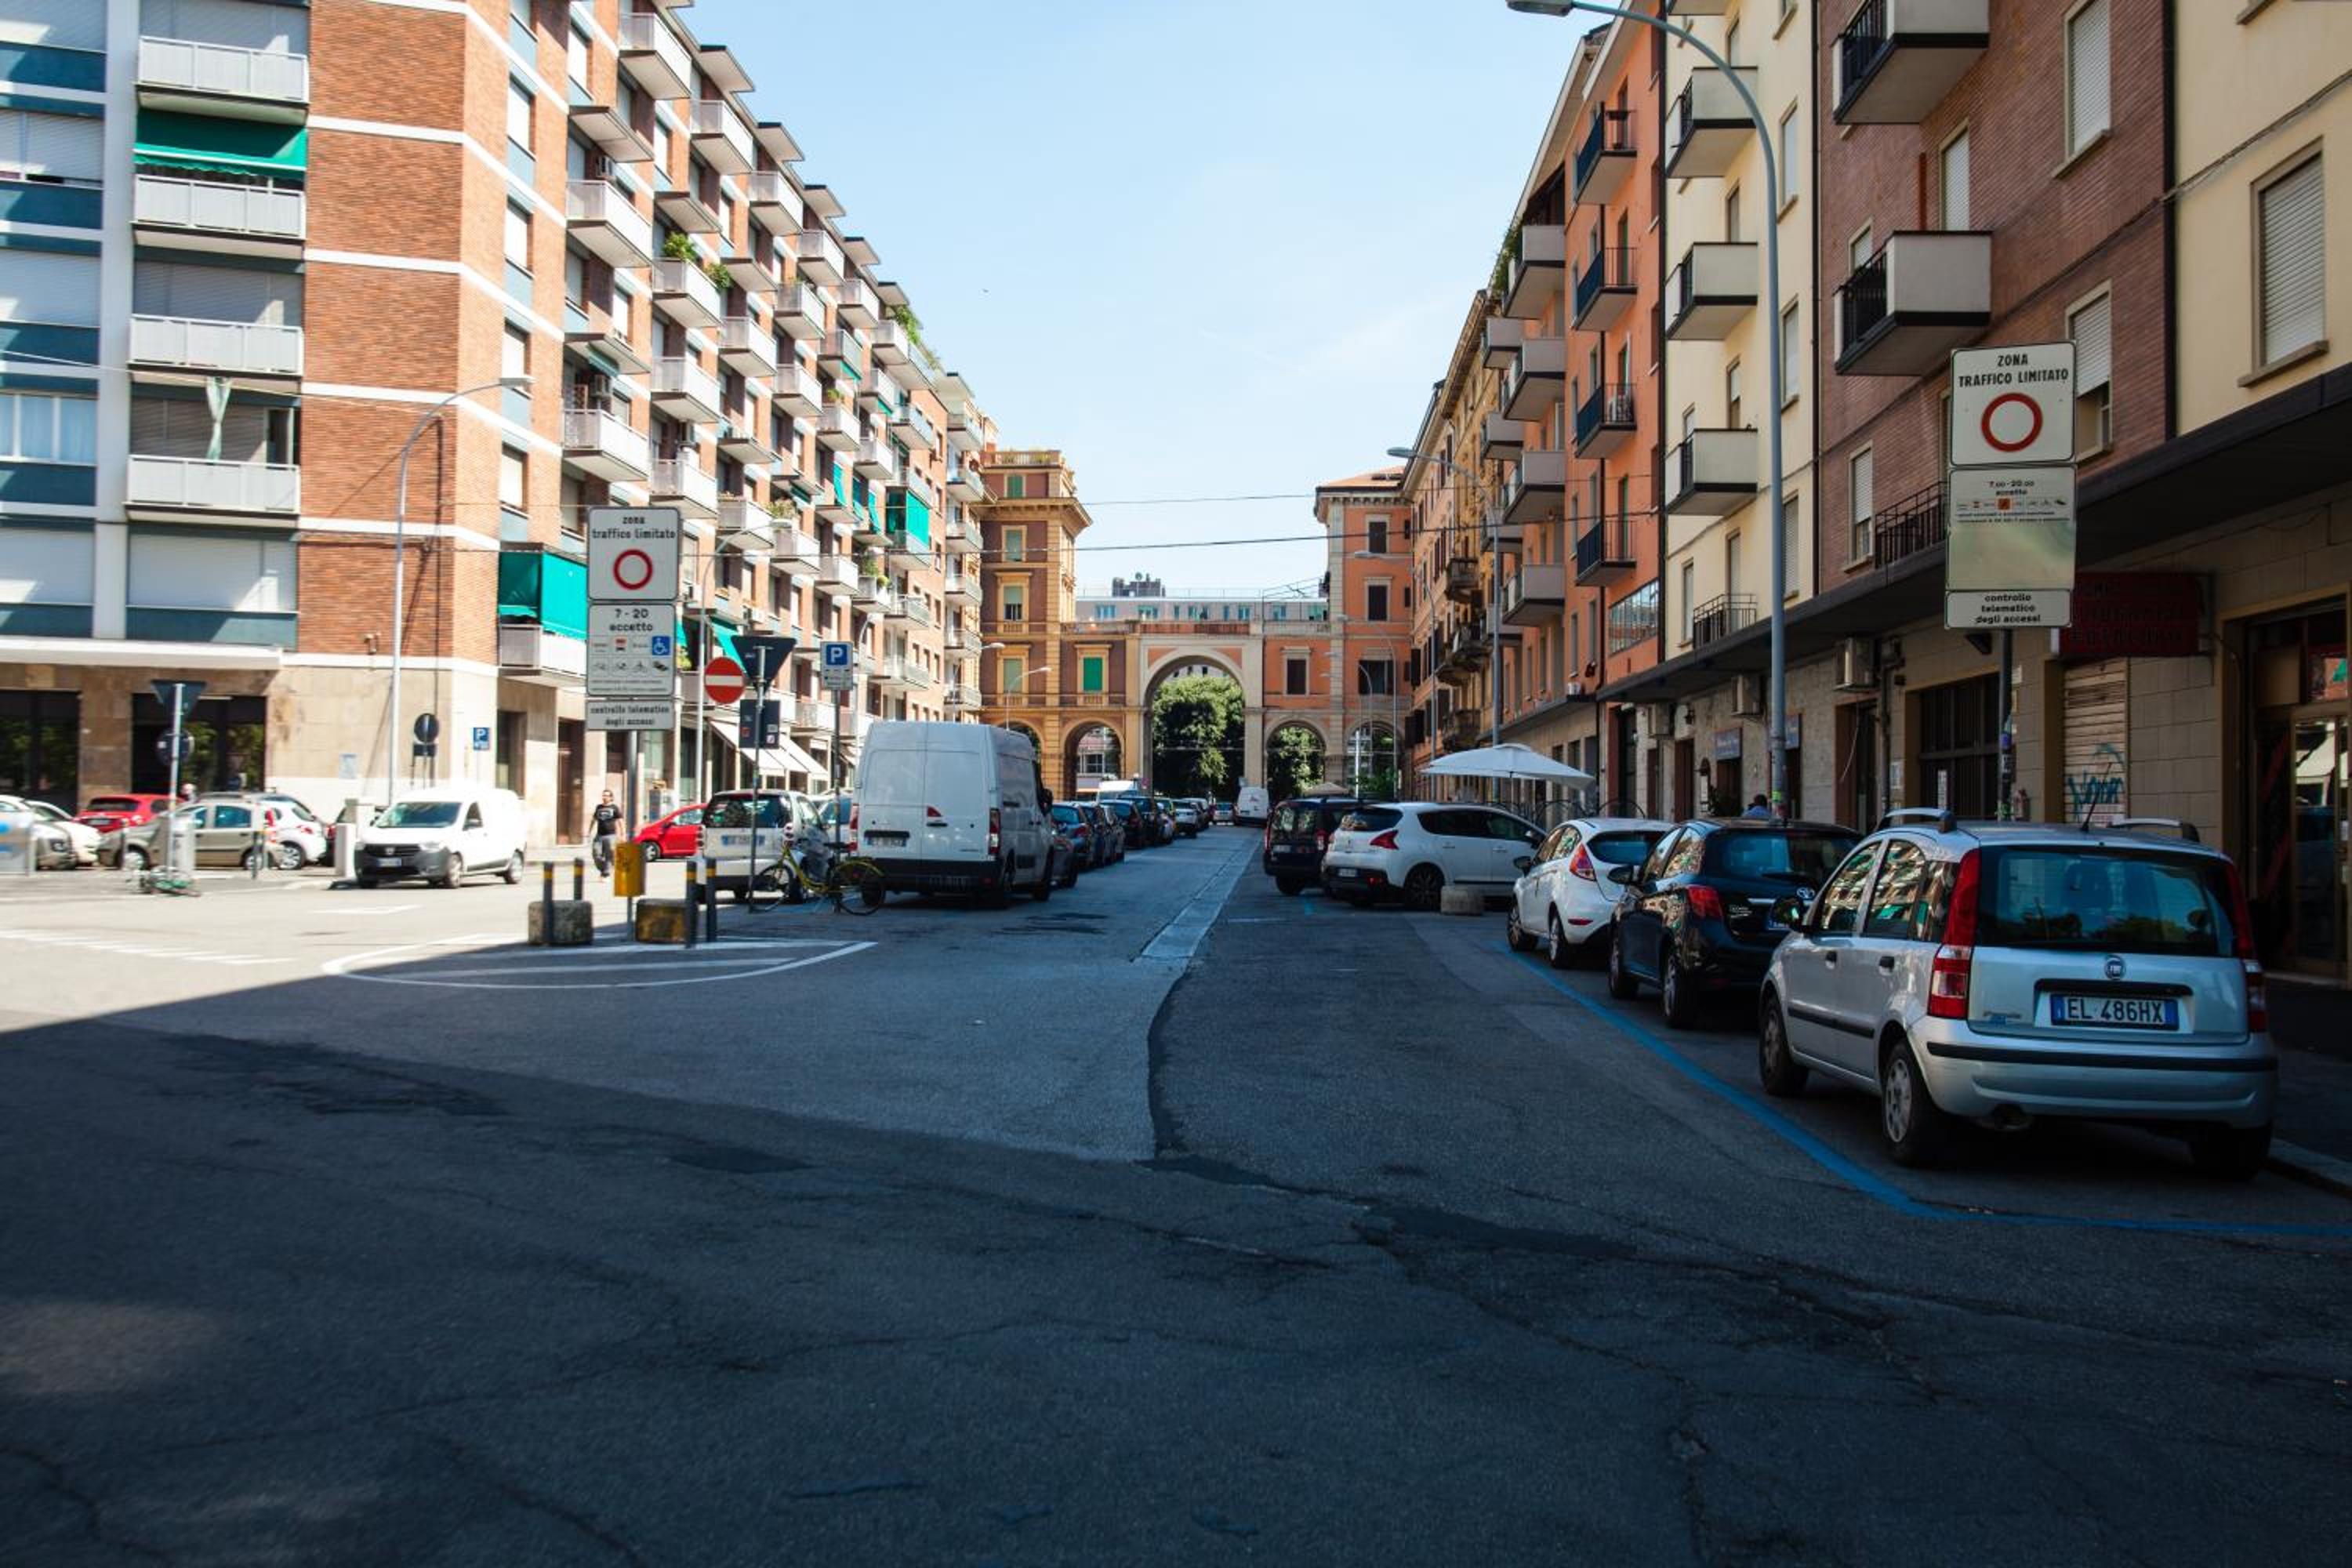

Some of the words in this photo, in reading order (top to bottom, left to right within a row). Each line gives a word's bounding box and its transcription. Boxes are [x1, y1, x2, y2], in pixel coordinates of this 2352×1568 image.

[1998, 354, 2028, 367] ZONA
[1958, 372, 2013, 387] TRAFFICO
[2018, 368, 2069, 383] LIMITATO
[592, 528, 630, 539] traffico
[635, 528, 676, 539] limitato
[1984, 593, 2031, 602] controllo
[615, 608, 622, 619] 7
[633, 608, 649, 619] 20
[1981, 604, 2035, 612] telematico
[1976, 614, 2000, 624] degli
[2003, 614, 2041, 622] accessi
[609, 622, 653, 631] eccetto
[831, 647, 843, 663] P
[2067, 998, 2092, 1018] EL
[2100, 1000, 2163, 1023] 486HX
